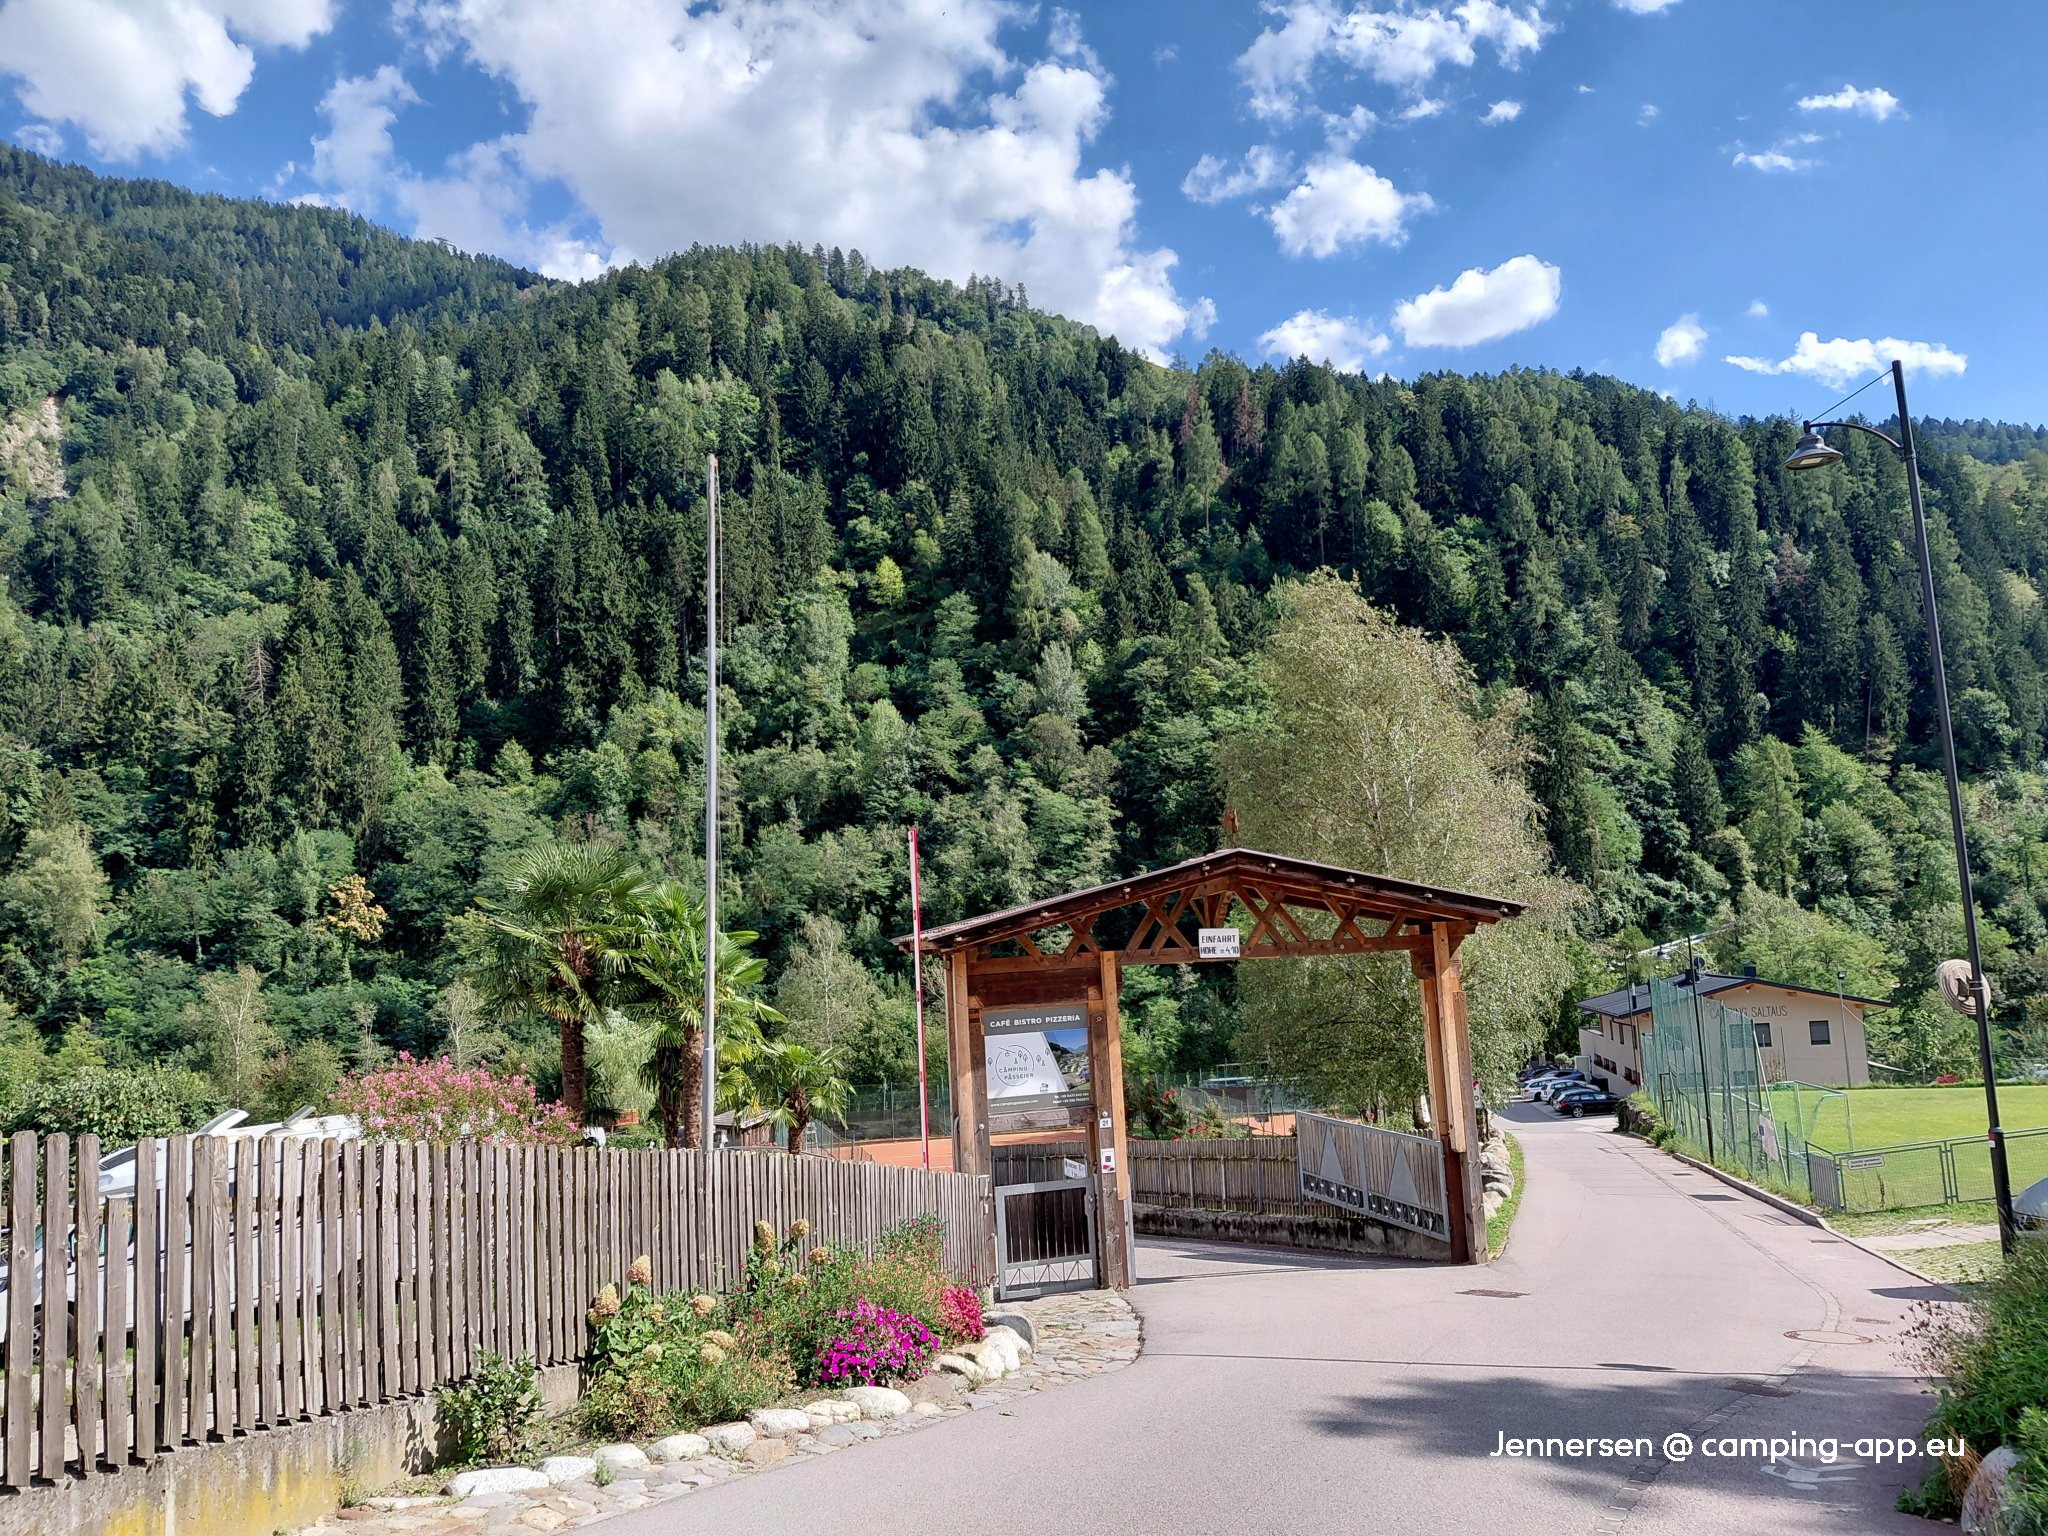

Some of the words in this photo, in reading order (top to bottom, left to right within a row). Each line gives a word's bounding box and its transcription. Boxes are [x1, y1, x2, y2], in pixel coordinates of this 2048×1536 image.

[1201, 935, 1236, 943] EINFAHRT
[1709, 1006, 1748, 1019] CAPING
[1751, 1005, 1788, 1018] SALTAUS
[990, 1018, 1011, 1028] CAFÉ
[1014, 1017, 1042, 1026] BISTRO
[1045, 1014, 1080, 1023] PIZZERIA
